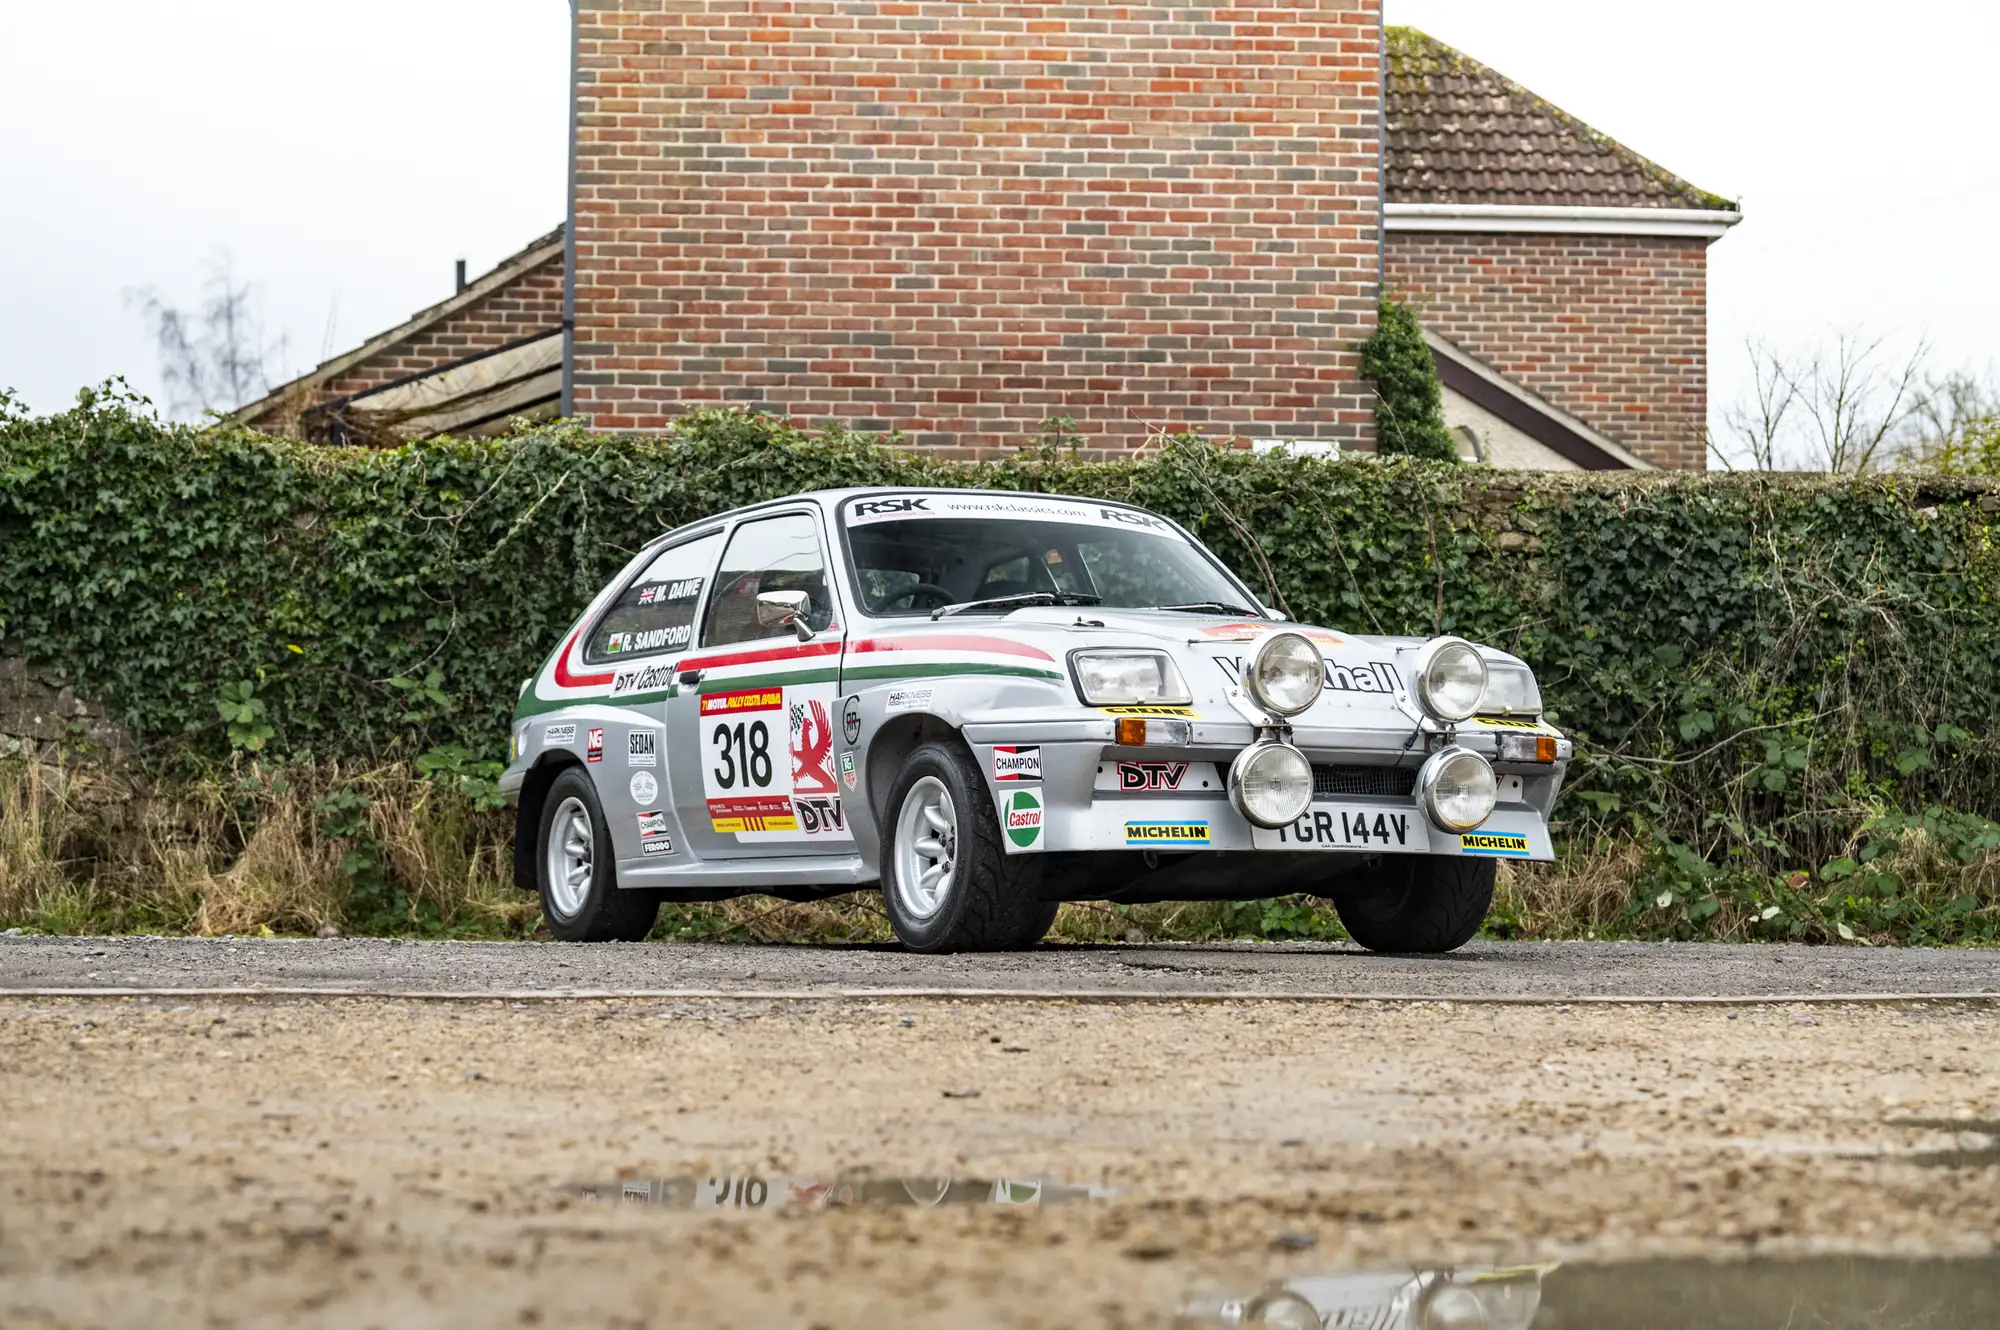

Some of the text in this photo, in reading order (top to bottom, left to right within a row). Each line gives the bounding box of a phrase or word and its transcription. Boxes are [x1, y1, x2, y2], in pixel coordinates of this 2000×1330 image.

[855, 498, 931, 517] RSK
[947, 503, 1087, 517] www.rskclassics.com
[1100, 509, 1167, 532] RSK
[654, 578, 701, 602] M. DAWE
[622, 624, 692, 652] R. SANDFORD
[615, 672, 640, 692] DTV
[889, 690, 933, 702] HARKNESS
[588, 730, 603, 749] NG
[629, 733, 655, 755] SEDAN
[713, 720, 773, 789] 318
[996, 758, 1040, 769] CHAMPION
[1119, 764, 1186, 789] DTV
[641, 819, 665, 829] CHAMPION
[795, 798, 843, 832] DTV
[1009, 810, 1041, 827] Castrol
[1126, 826, 1208, 838] MICHELIN
[1341, 812, 1406, 845] 144V
[644, 842, 670, 852] FERODO
[1462, 836, 1527, 849] MICHELIN
